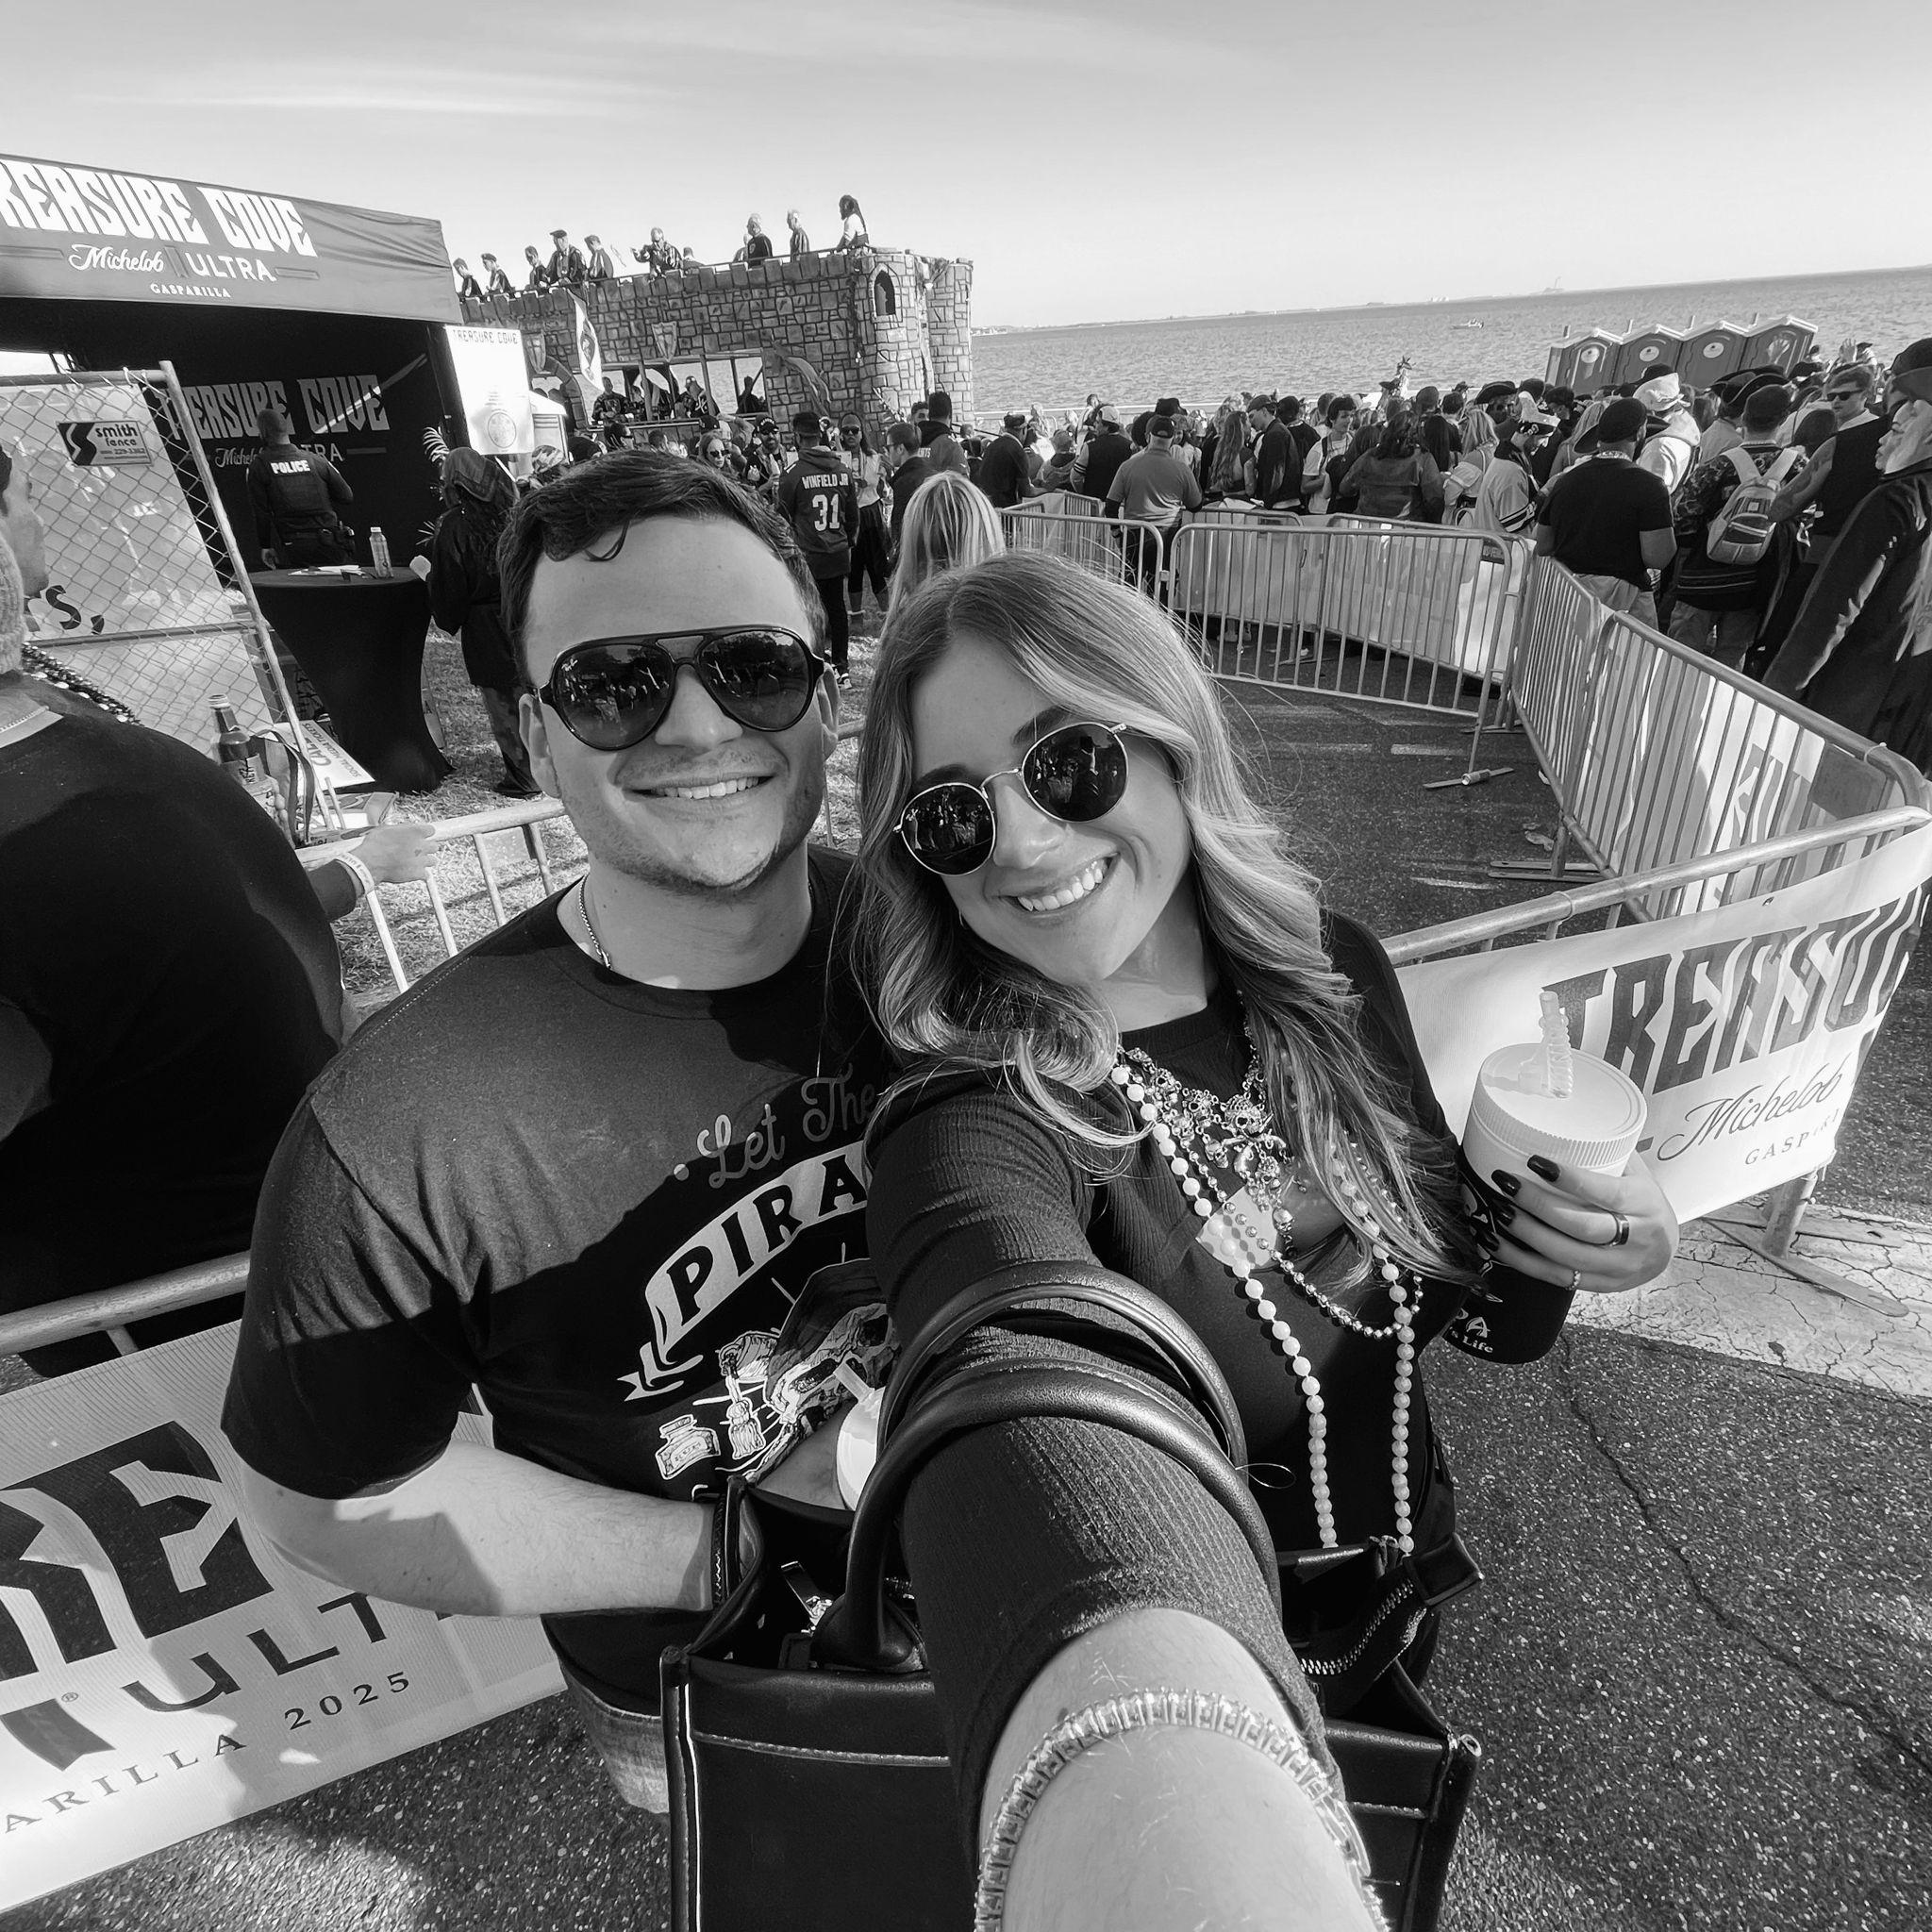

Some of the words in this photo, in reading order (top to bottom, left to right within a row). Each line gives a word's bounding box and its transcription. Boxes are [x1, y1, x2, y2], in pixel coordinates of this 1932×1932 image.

[196, 186, 318, 258] COVE
[68, 243, 164, 272] Michelob
[185, 252, 277, 282] ULTRA
[150, 283, 232, 298] GASPARILLA
[154, 380, 296, 441] TEASURE
[296, 375, 391, 434] COVE
[95, 424, 138, 437] smith
[106, 438, 138, 446] fence
[271, 460, 311, 474] POLICE
[802, 474, 838, 490] WINFIELD
[812, 493, 840, 531] 31
[1657, 1052, 1852, 1160] Michelob
[696, 1103, 785, 1189] Let
[801, 1063, 876, 1141] The
[1462, 1335, 1493, 1353] Life
[284, 1671, 409, 1730] 2025
